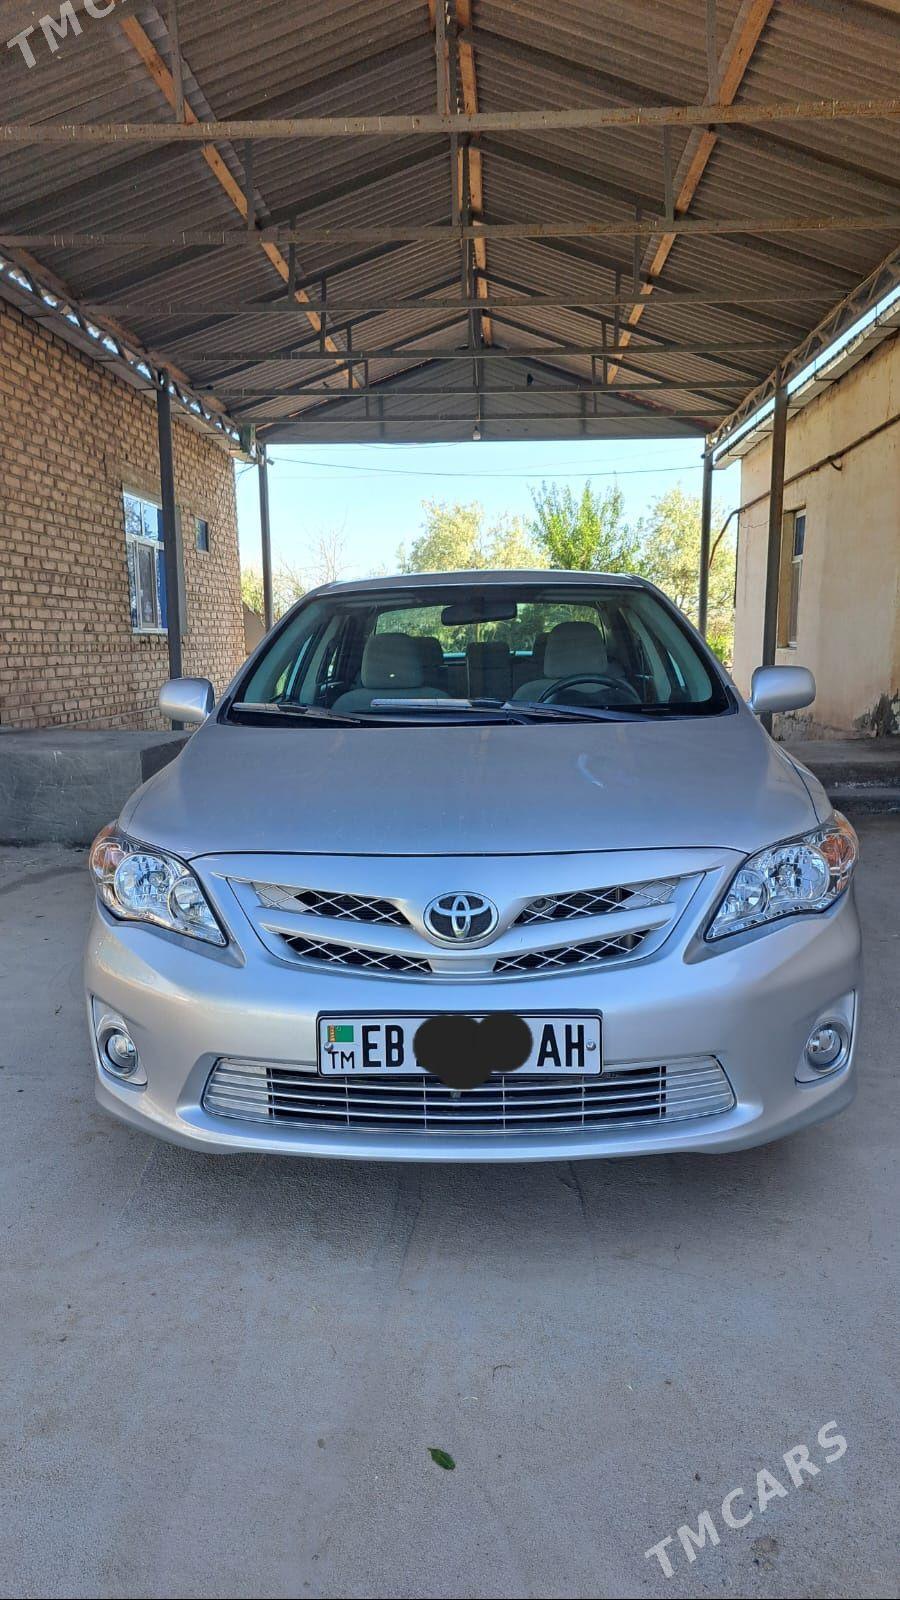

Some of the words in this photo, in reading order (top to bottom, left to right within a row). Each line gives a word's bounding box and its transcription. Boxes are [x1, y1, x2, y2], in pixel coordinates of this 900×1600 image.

[327, 1051, 355, 1069] TM
[361, 1025, 404, 1067] EB
[536, 1024, 585, 1067] AH
